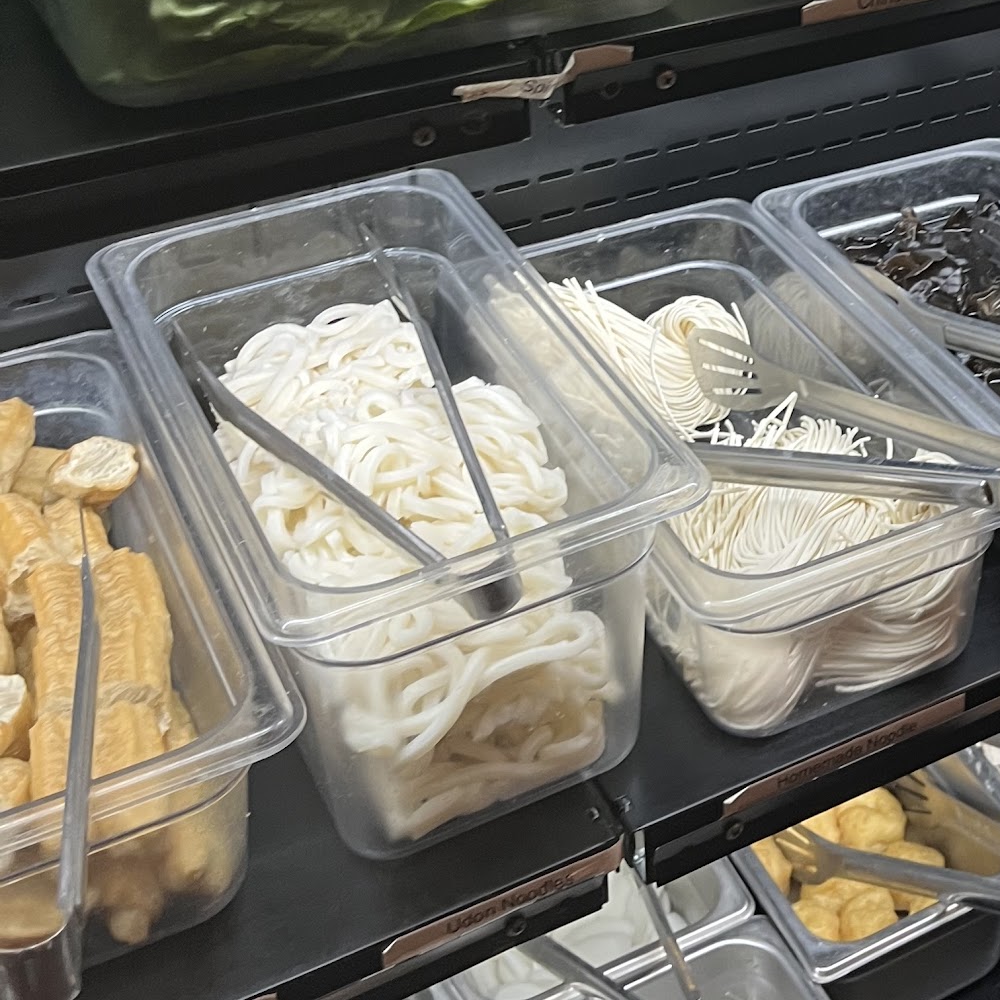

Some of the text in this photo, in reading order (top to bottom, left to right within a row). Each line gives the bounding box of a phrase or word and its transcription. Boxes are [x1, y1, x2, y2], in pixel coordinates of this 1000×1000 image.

[776, 743, 863, 788] Homemade
[446, 873, 574, 933] Udon Noodles
